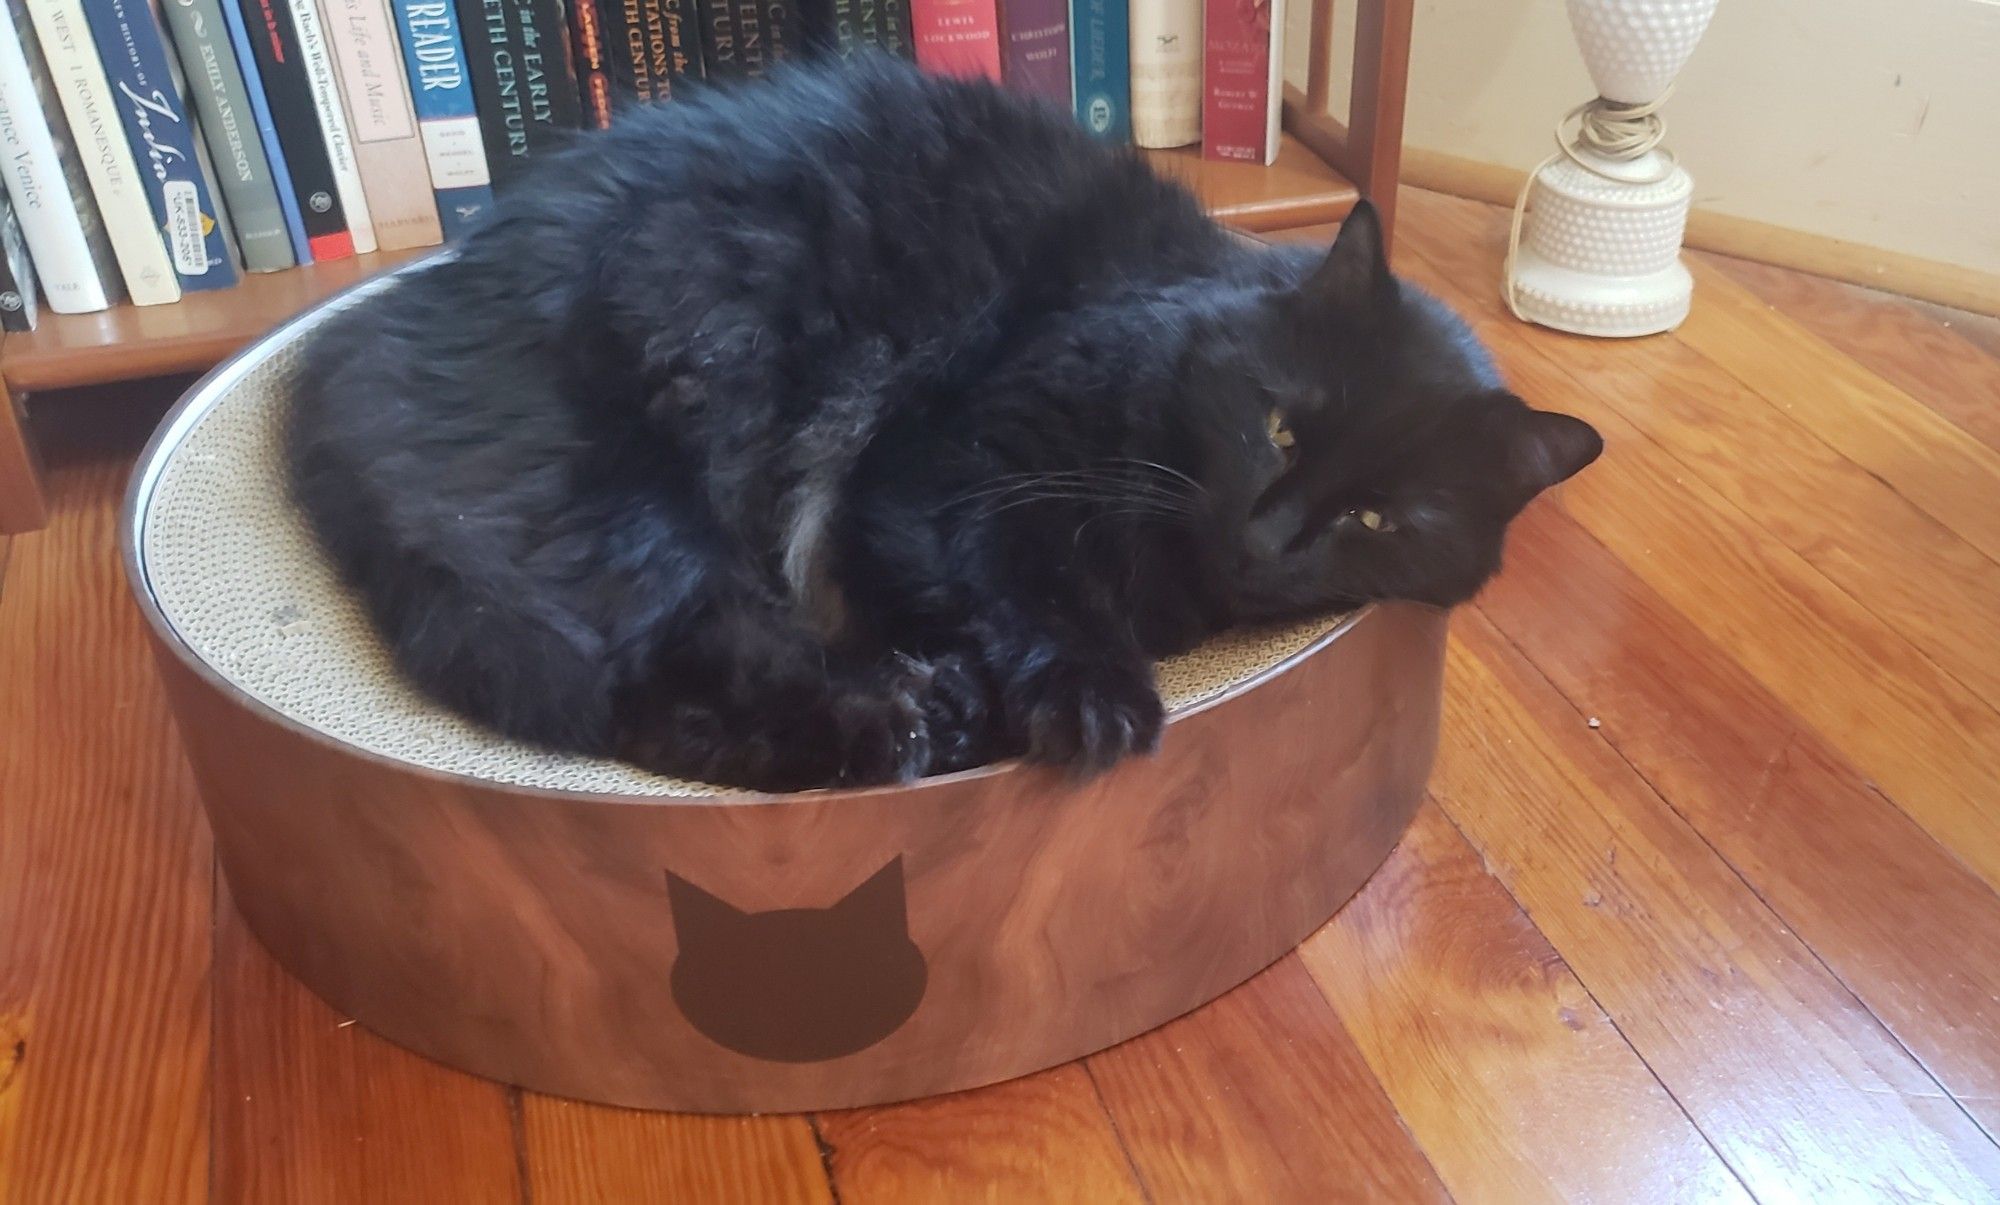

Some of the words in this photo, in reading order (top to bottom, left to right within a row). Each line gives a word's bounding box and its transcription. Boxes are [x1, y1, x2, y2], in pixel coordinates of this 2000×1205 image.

[348, 16, 373, 46] Life
[520, 9, 534, 23] in
[523, 26, 541, 48] the
[663, 10, 683, 48] from
[674, 51, 688, 74] the
[923, 30, 991, 43] LOCKWOOD
[937, 15, 975, 27] LEWIS
[120, 22, 140, 68] HISTORY
[357, 49, 380, 78] and
[405, 0, 462, 91] READER
[52, 9, 78, 52] WEST
[74, 77, 125, 187] ROMANESQUE
[137, 72, 147, 86] OF
[300, 13, 319, 49] Bach's
[331, 132, 349, 172] Clavier
[365, 82, 386, 127] Music
[493, 50, 529, 158] CENTURY
[523, 53, 553, 124] EARLY
[118, 80, 186, 181] India
[200, 43, 226, 95] EMILY
[215, 95, 254, 182] ANDERSON
[14, 150, 42, 208] Venice
